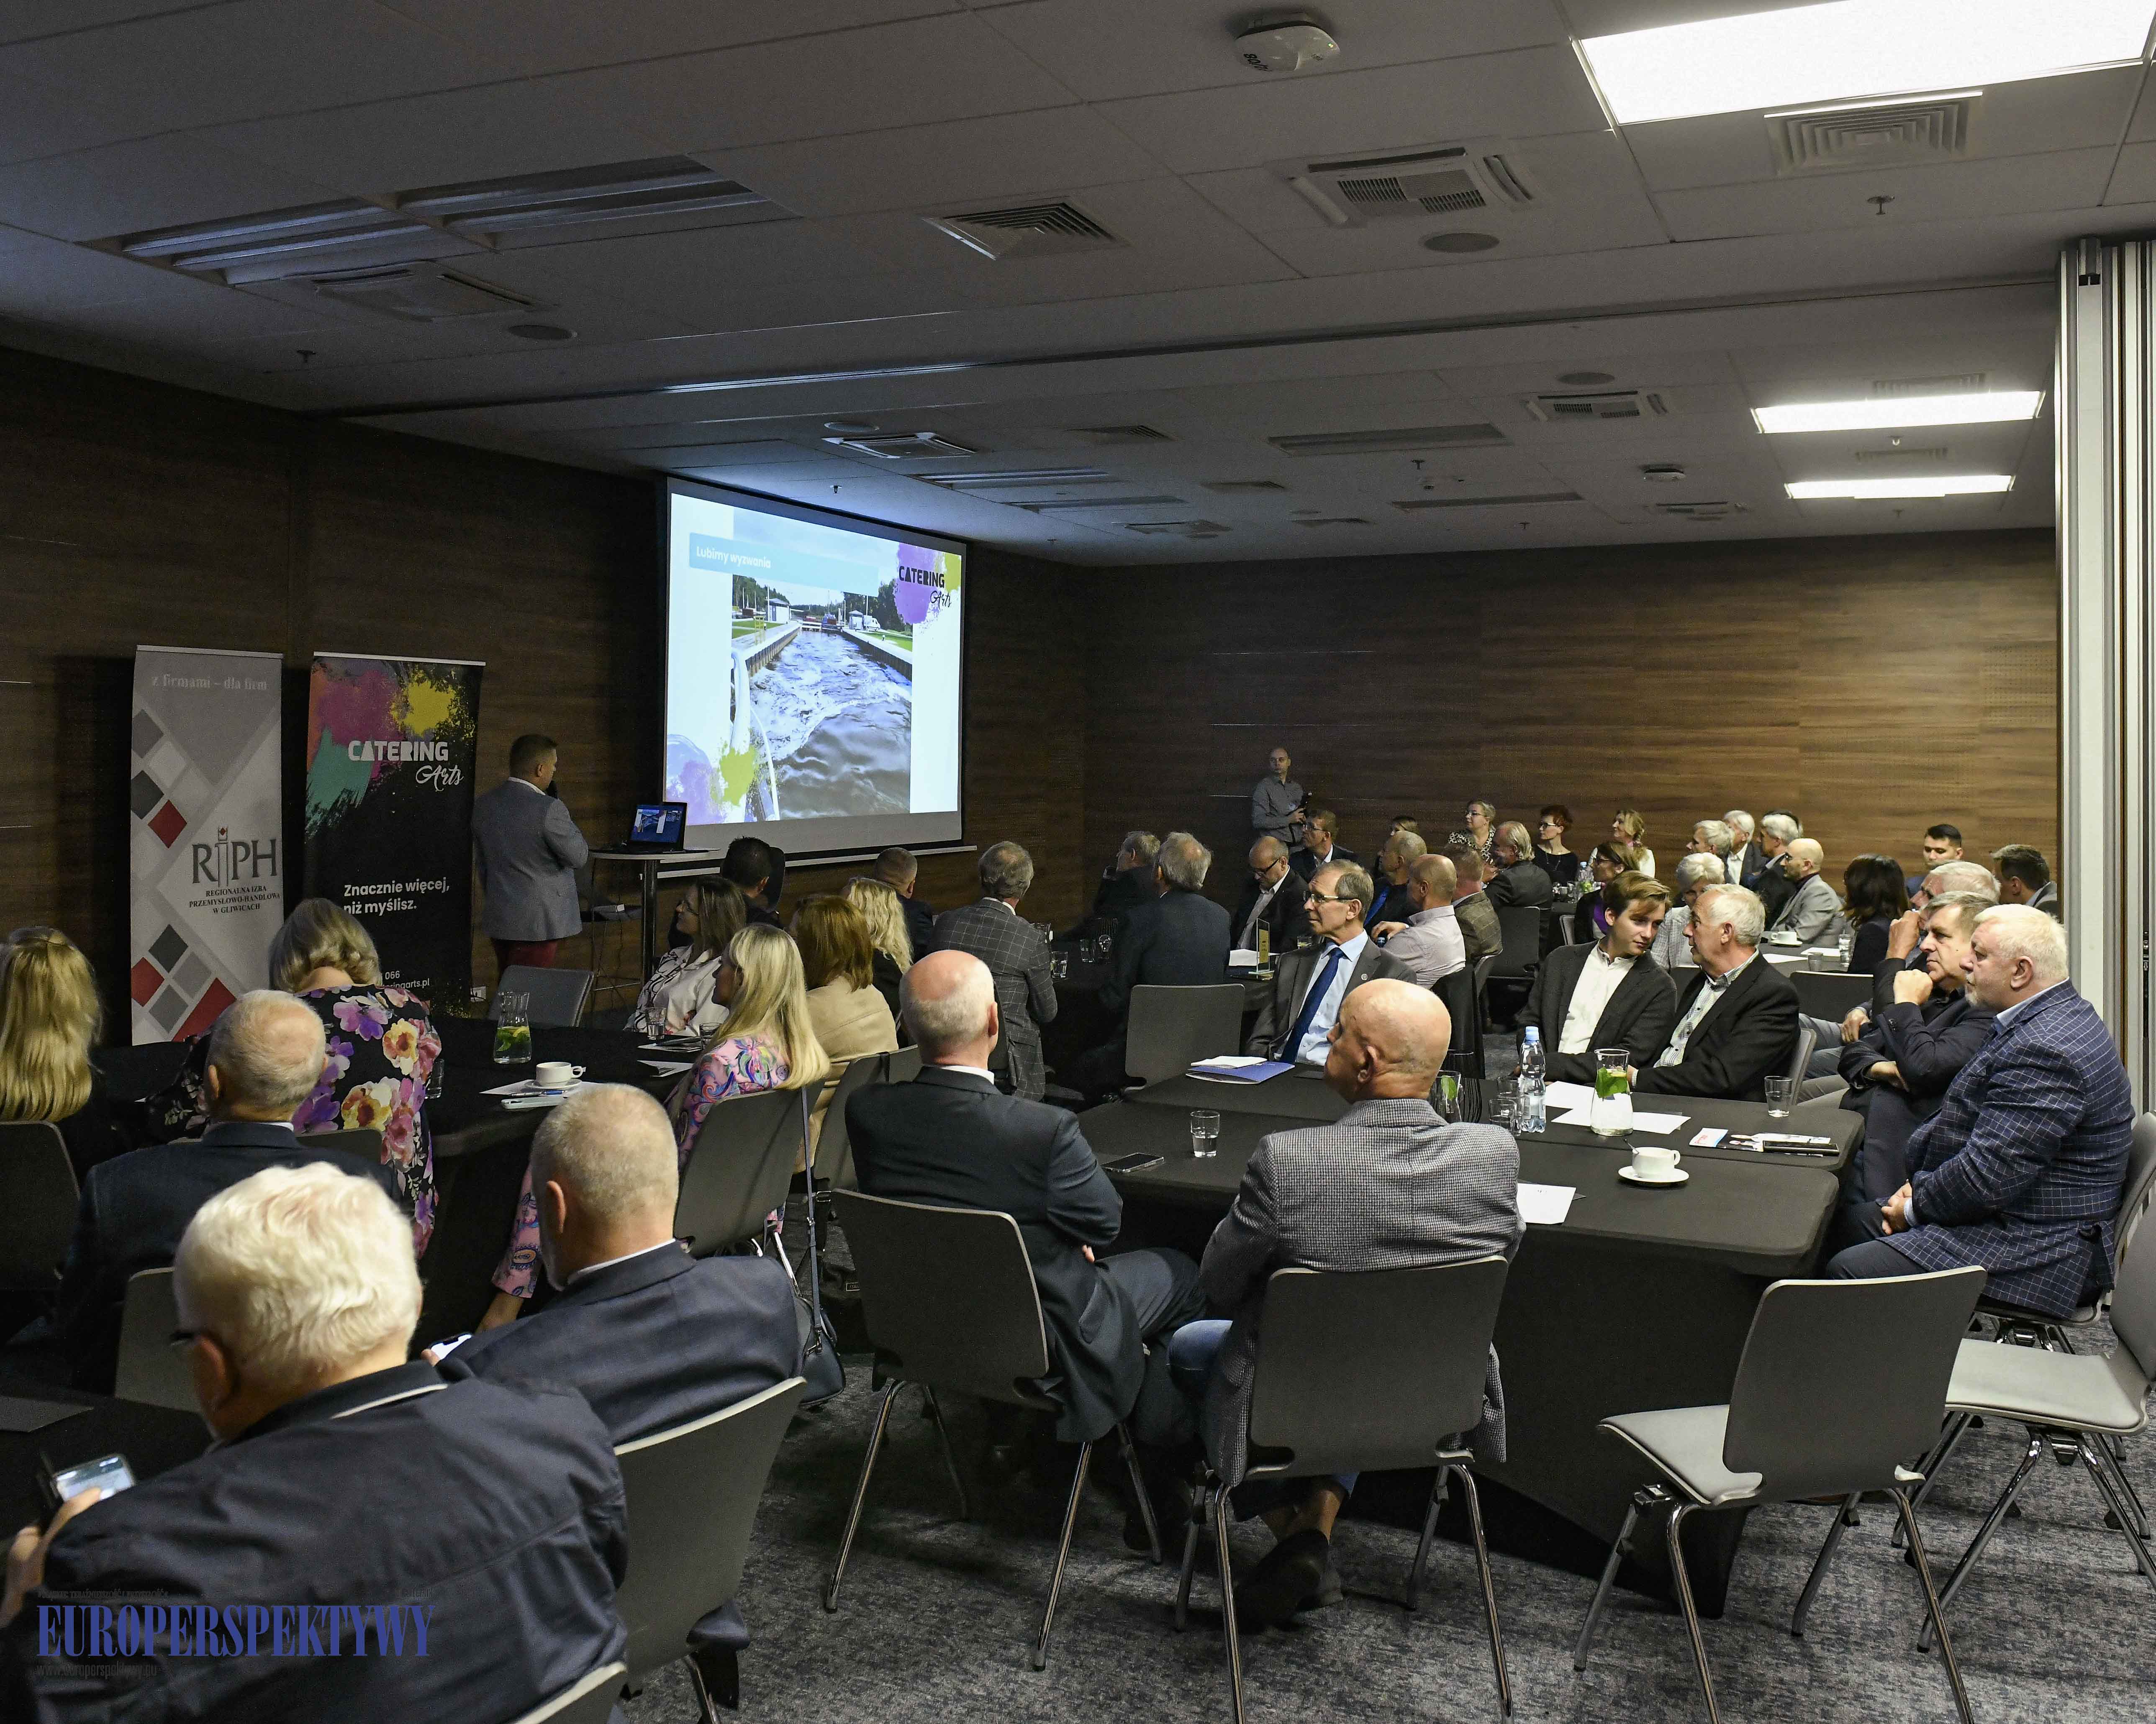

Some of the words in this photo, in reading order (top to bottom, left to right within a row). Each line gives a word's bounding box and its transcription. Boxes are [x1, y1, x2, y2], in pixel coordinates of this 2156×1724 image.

[696, 546, 729, 565] Lubimy
[730, 554, 771, 568] wyzwania
[898, 566, 945, 588] CATERING
[930, 590, 952, 610] Arts
[153, 677, 158, 687] z
[164, 674, 211, 689] firmami
[224, 676, 241, 690] dla
[244, 677, 269, 690] firm
[348, 740, 449, 761] CATERING
[415, 765, 464, 792] Arts
[206, 887, 250, 897] REGIONALNA
[344, 880, 403, 897] Znacznie
[405, 877, 450, 894] więcej,
[221, 903, 260, 913] GLIWICACH
[344, 901, 362, 914] niż
[364, 898, 418, 916] myślisz.
[385, 970, 400, 980] 066
